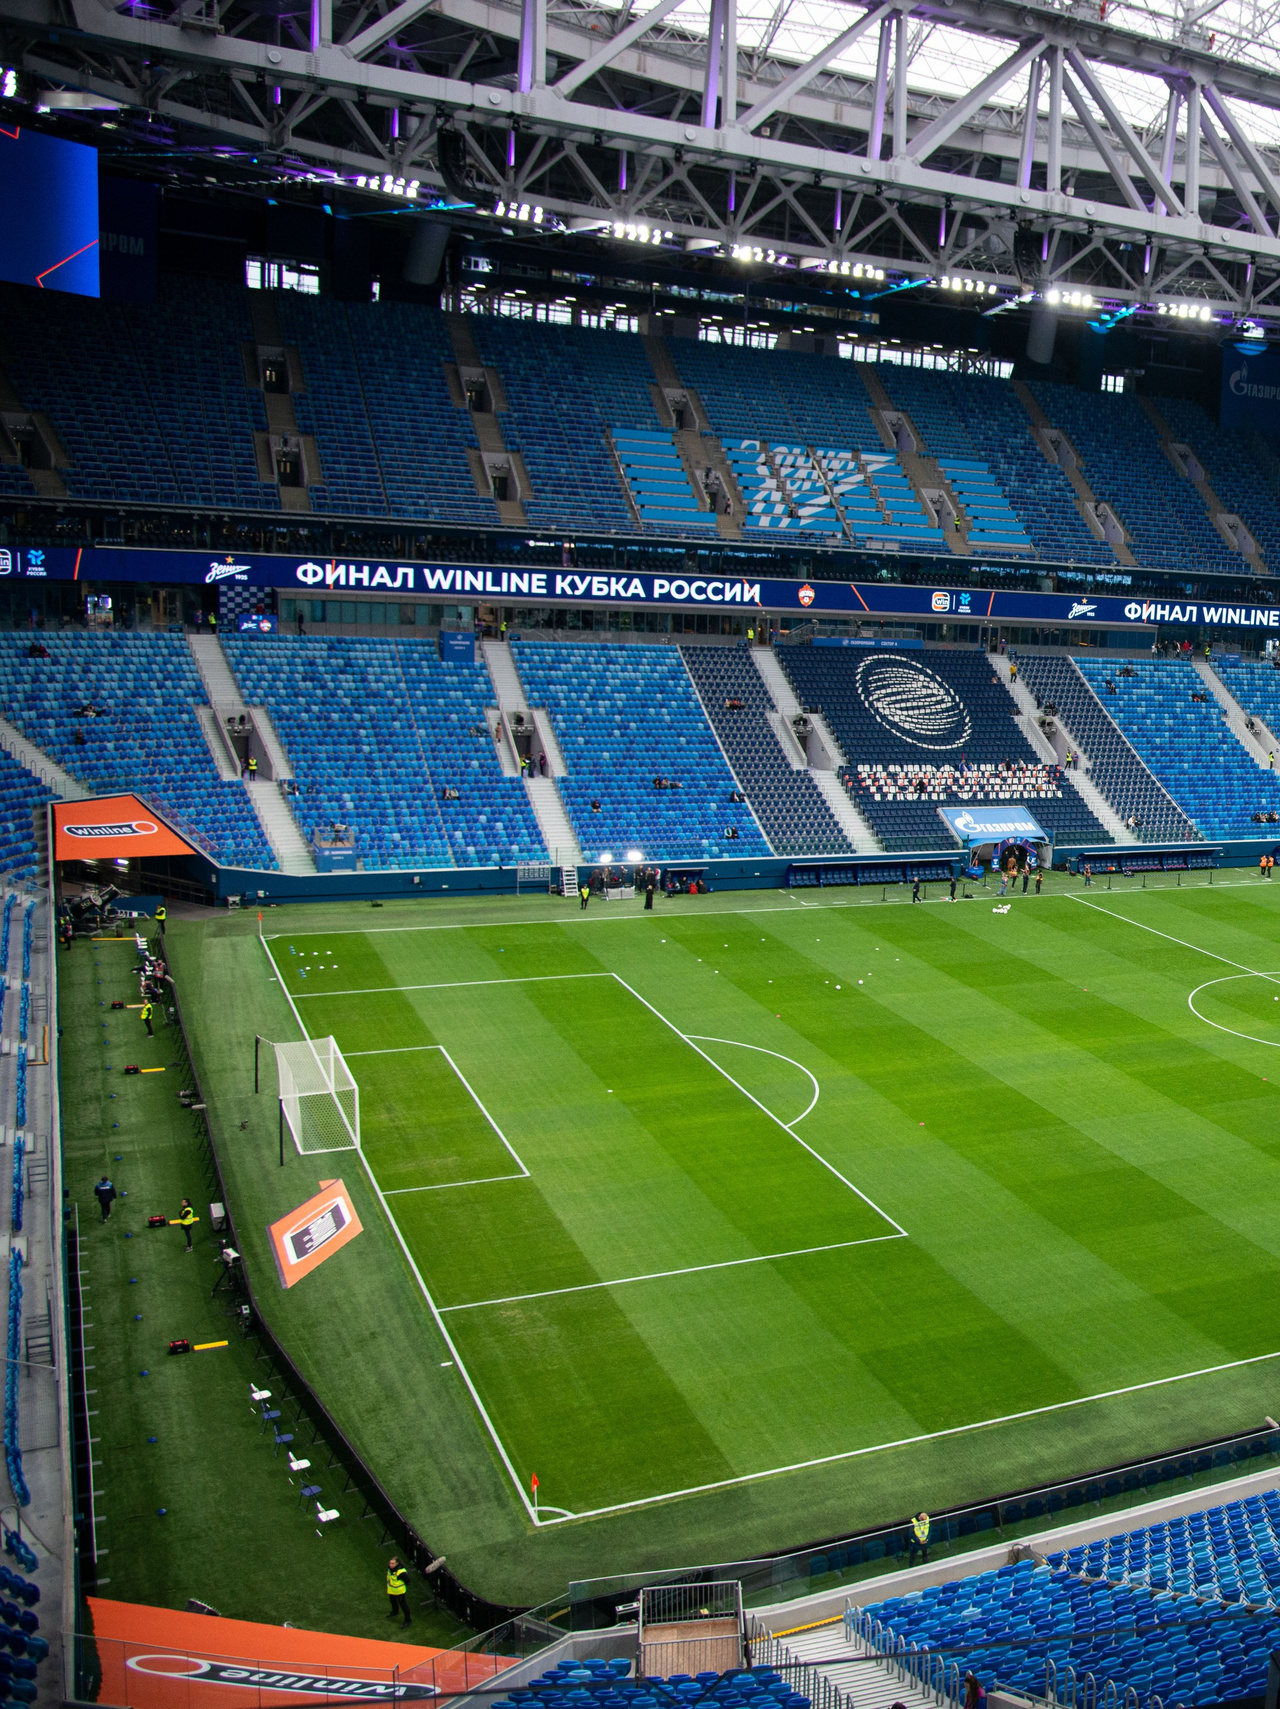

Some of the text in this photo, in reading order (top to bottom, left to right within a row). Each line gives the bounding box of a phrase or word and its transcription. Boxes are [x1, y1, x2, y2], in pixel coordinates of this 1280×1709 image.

[296, 561, 761, 603] ФИНАЛ WINLINE КУБКА РОССИИ
[1124, 602, 1197, 622] ФИНАЛ
[1203, 606, 1280, 626] WINLINE
[72, 826, 133, 836] Winline
[979, 822, 1037, 833] ГАЗПРОМ
